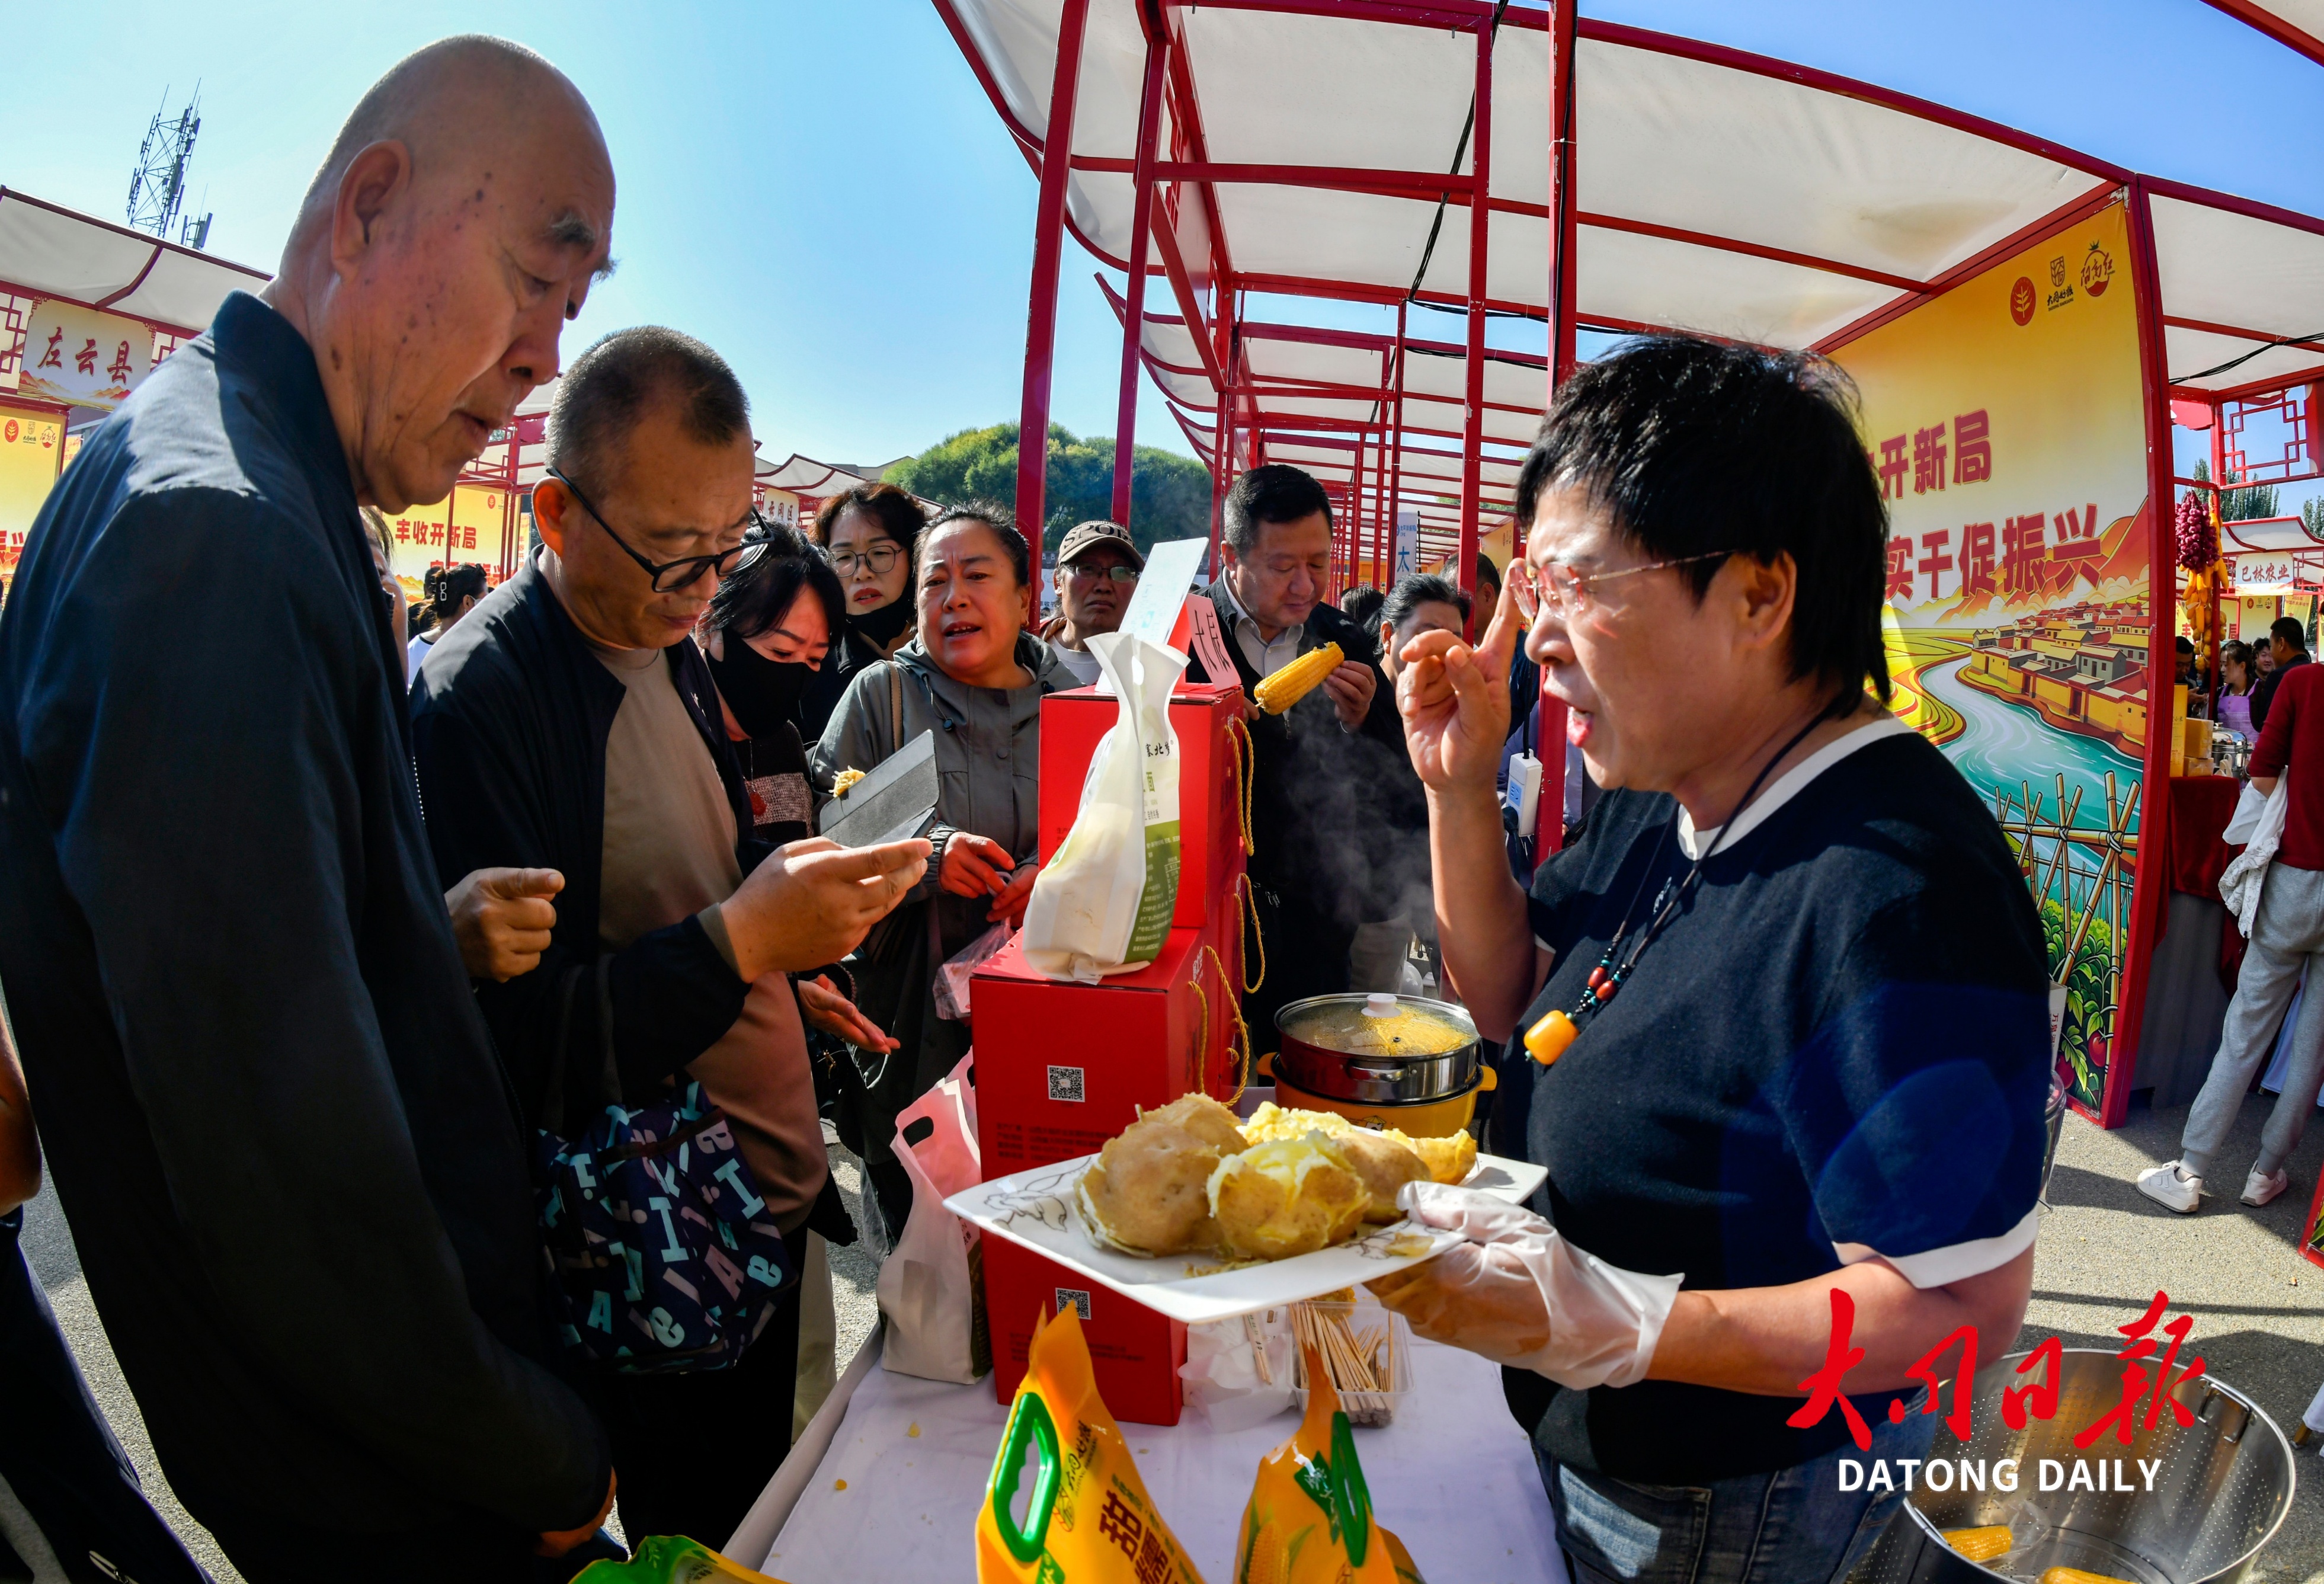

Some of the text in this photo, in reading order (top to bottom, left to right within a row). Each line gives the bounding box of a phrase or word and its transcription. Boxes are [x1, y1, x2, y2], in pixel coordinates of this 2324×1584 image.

[38, 327, 132, 385] 左云县
[1868, 408, 1992, 501] 开新局
[1397, 546, 1410, 572] 太
[1885, 503, 2103, 600] 实干促振兴
